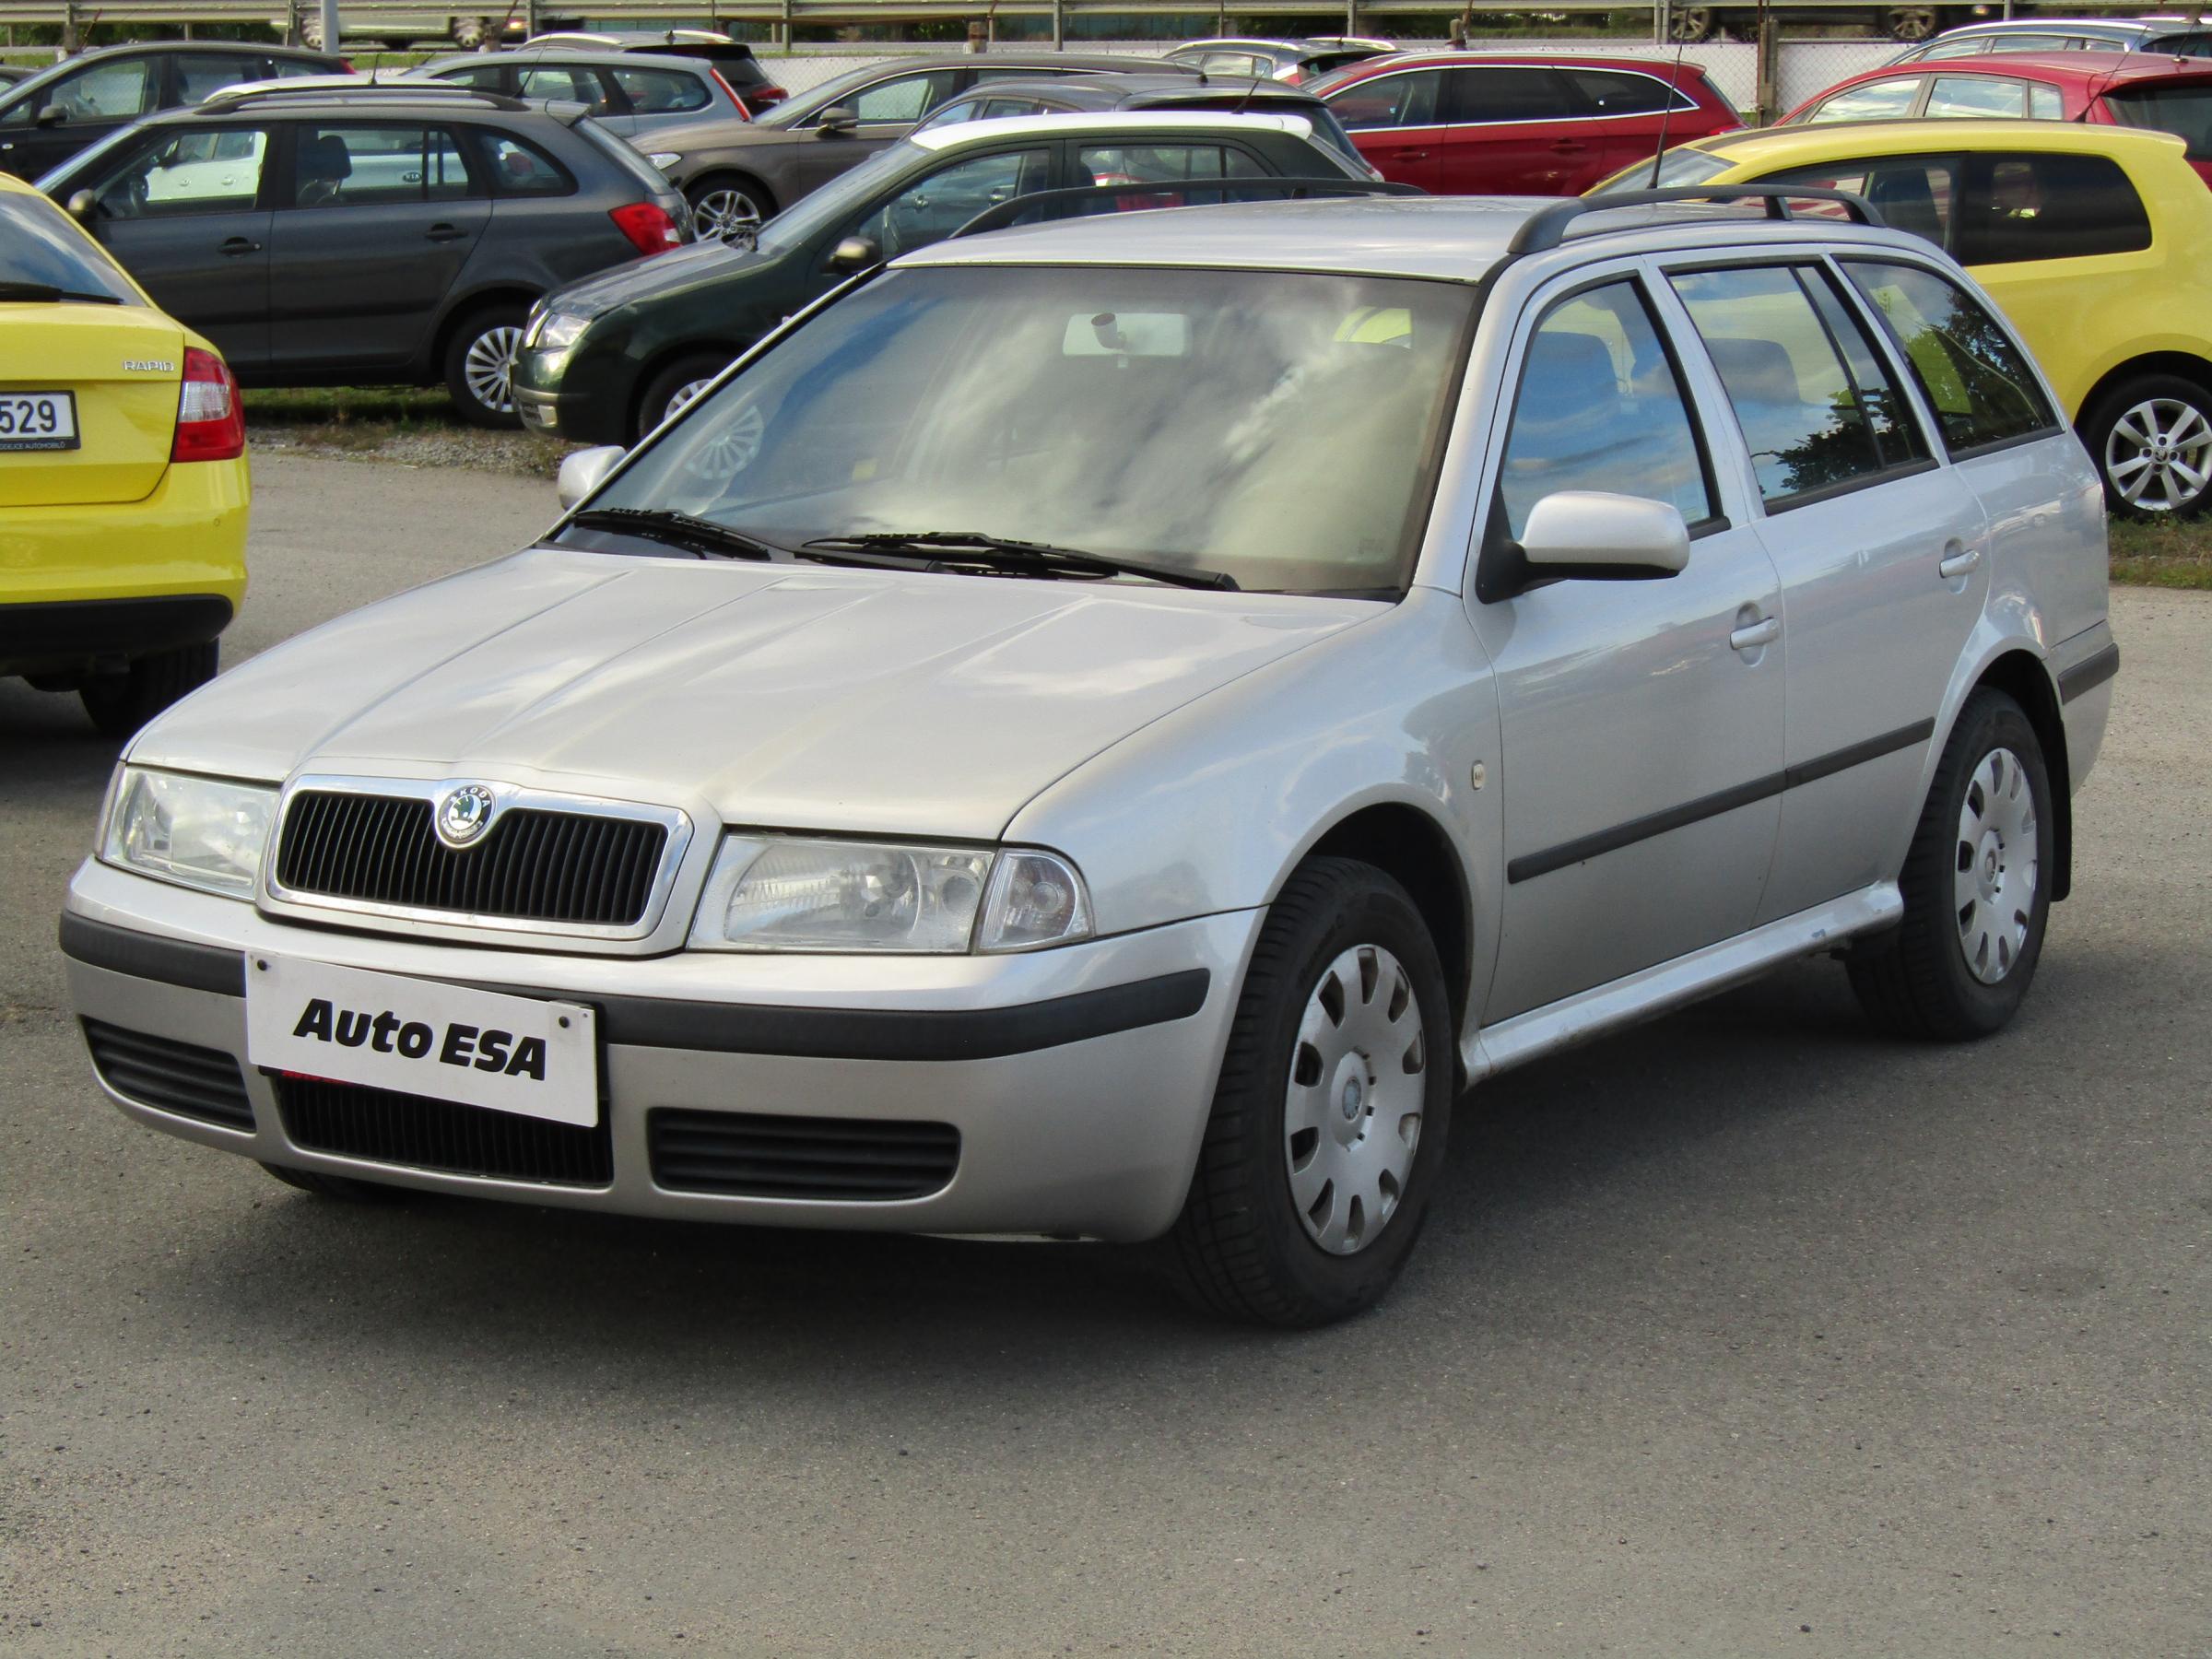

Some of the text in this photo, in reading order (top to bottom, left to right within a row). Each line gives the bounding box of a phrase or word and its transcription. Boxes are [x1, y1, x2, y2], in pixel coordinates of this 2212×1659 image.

[124, 360, 175, 371] RAPID
[0, 400, 57, 433] 529
[292, 997, 547, 1082] Auto ESA
